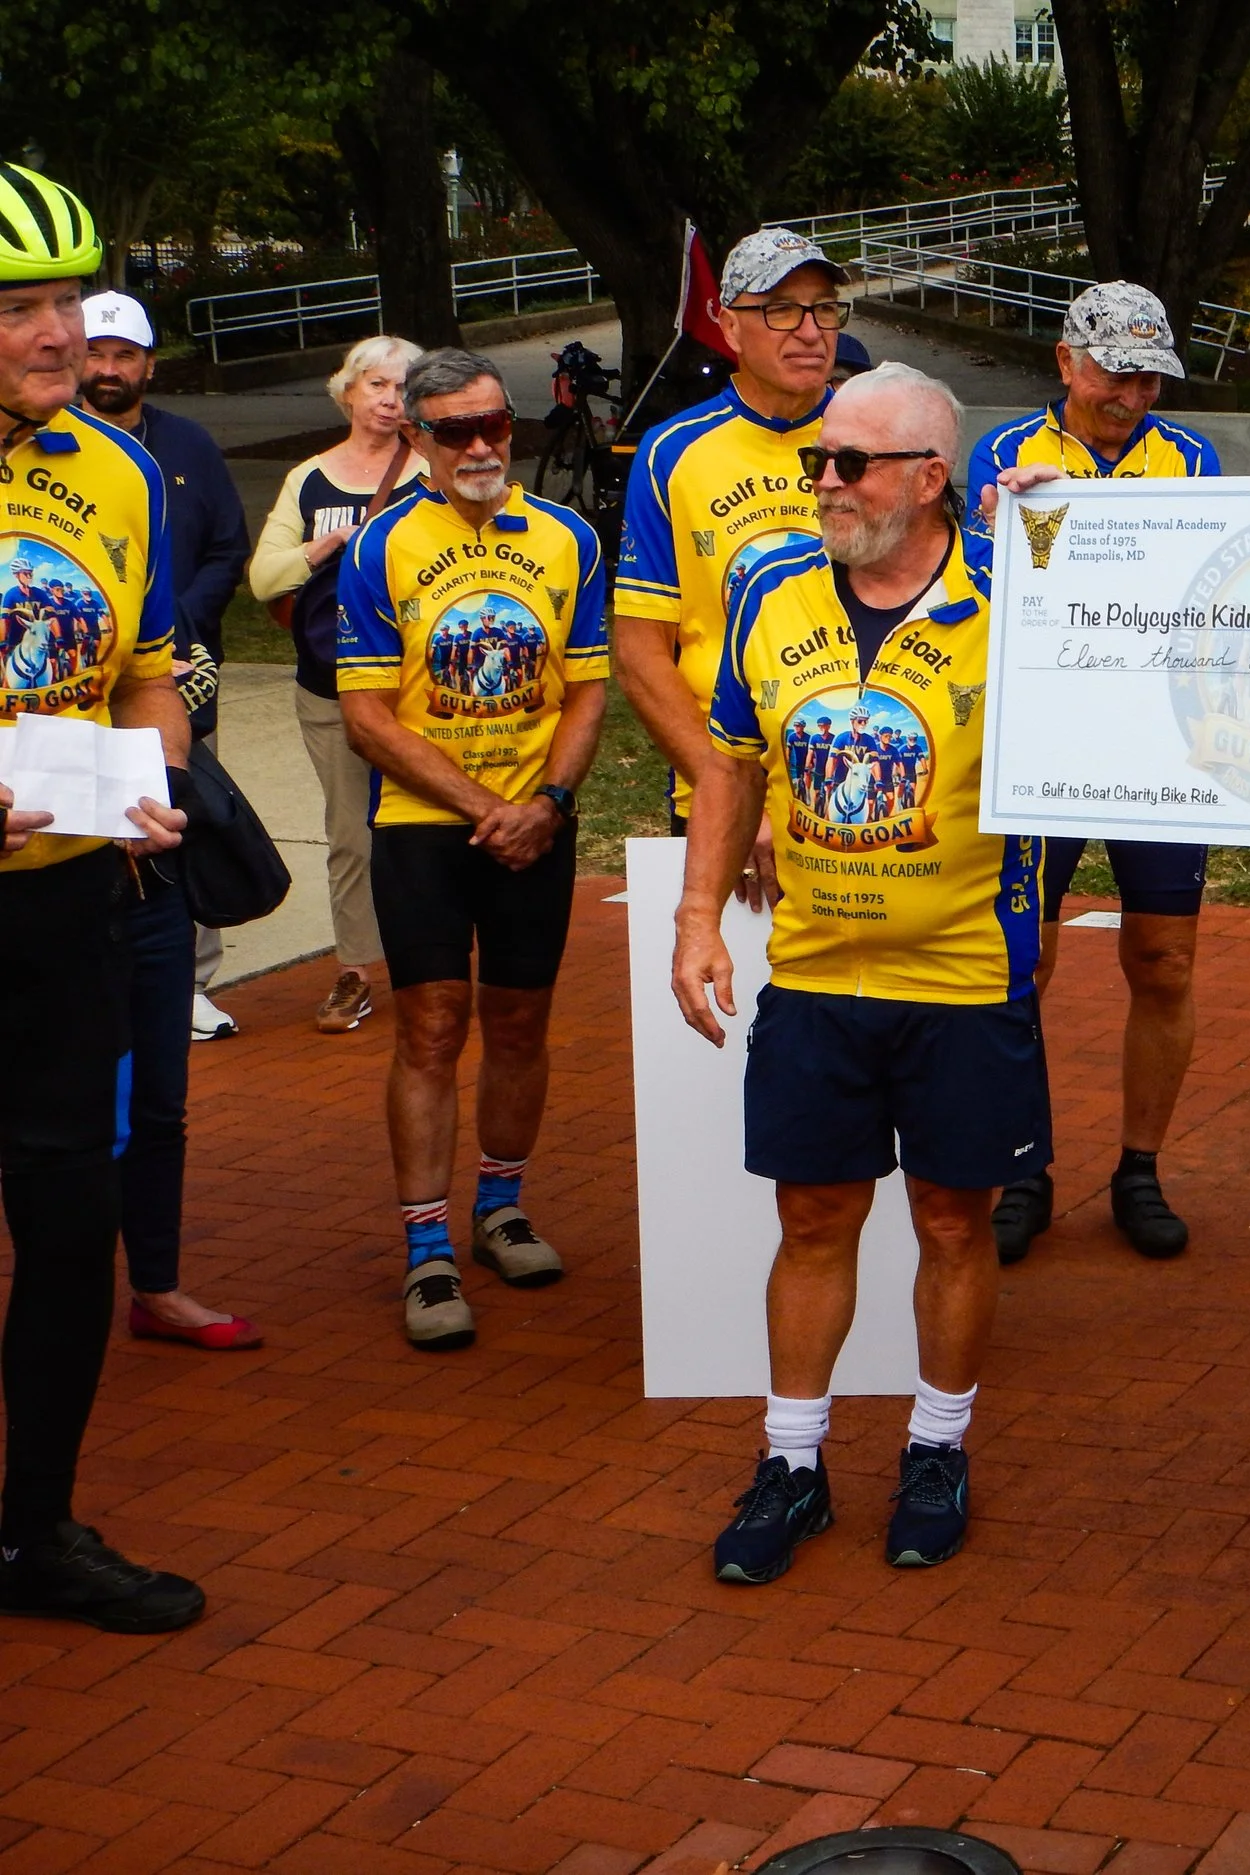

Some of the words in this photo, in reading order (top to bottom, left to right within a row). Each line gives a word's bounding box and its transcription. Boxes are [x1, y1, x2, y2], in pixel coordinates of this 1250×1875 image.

[101, 311, 116, 323] N
[175, 476, 185, 486] N
[26, 467, 97, 524] Goat
[710, 477, 756, 518] Gulf
[762, 476, 788, 493] to
[7, 502, 44, 520] BIKE
[48, 513, 85, 541] RIDE
[726, 507, 776, 535] CHARITY
[780, 505, 808, 516] BIKE
[1070, 519, 1105, 531] United
[1107, 519, 1140, 531] States
[1142, 519, 1174, 531] Naval
[1176, 519, 1227, 532] Academy
[691, 530, 716, 557] N
[1069, 534, 1098, 546] Class
[1099, 534, 1111, 546] of
[1113, 536, 1137, 547] 1975
[416, 547, 457, 587] Gulf
[461, 542, 488, 559] to
[495, 543, 546, 581] Goat
[1068, 549, 1124, 563] Annapolis,
[1127, 550, 1145, 561] MD
[431, 571, 477, 601] CHARITY
[480, 569, 507, 580] BIKE
[509, 574, 535, 593] RIDE
[398, 598, 421, 624] N
[1022, 596, 1044, 607] PAY
[1034, 609, 1048, 617] THE
[1067, 603, 1101, 627] The
[1106, 603, 1206, 634] Polycystic
[780, 626, 829, 667] Gulf
[900, 631, 952, 674] Goat
[1056, 639, 1128, 669] Eleven
[1141, 646, 1237, 669] thousand
[793, 659, 850, 687] CHARITY
[901, 667, 932, 691] RIDE
[45, 677, 94, 707] GOAT
[439, 693, 481, 713] GULF
[501, 687, 535, 710] GOAT
[760, 680, 780, 710] N
[423, 727, 452, 740] UNITED
[455, 725, 484, 739] STATES
[486, 724, 516, 736] NAVAL
[462, 750, 485, 759] Class
[1012, 784, 1035, 797] FOR
[1041, 782, 1068, 798] Gulf
[1068, 785, 1081, 799] to
[1082, 784, 1112, 800] Goat
[1114, 784, 1158, 805] Charity
[1160, 787, 1187, 804] Bike
[1190, 787, 1219, 804] Ride
[795, 810, 836, 843] GULF
[861, 817, 913, 845] GOAT
[805, 856, 838, 874] STATES
[840, 860, 878, 877] NAVAL
[881, 861, 942, 878] ACADEMY
[812, 888, 838, 902] Class
[840, 892, 852, 904] of
[854, 893, 885, 904] 1975
[812, 904, 835, 917] 50th
[837, 907, 887, 921] Reunion
